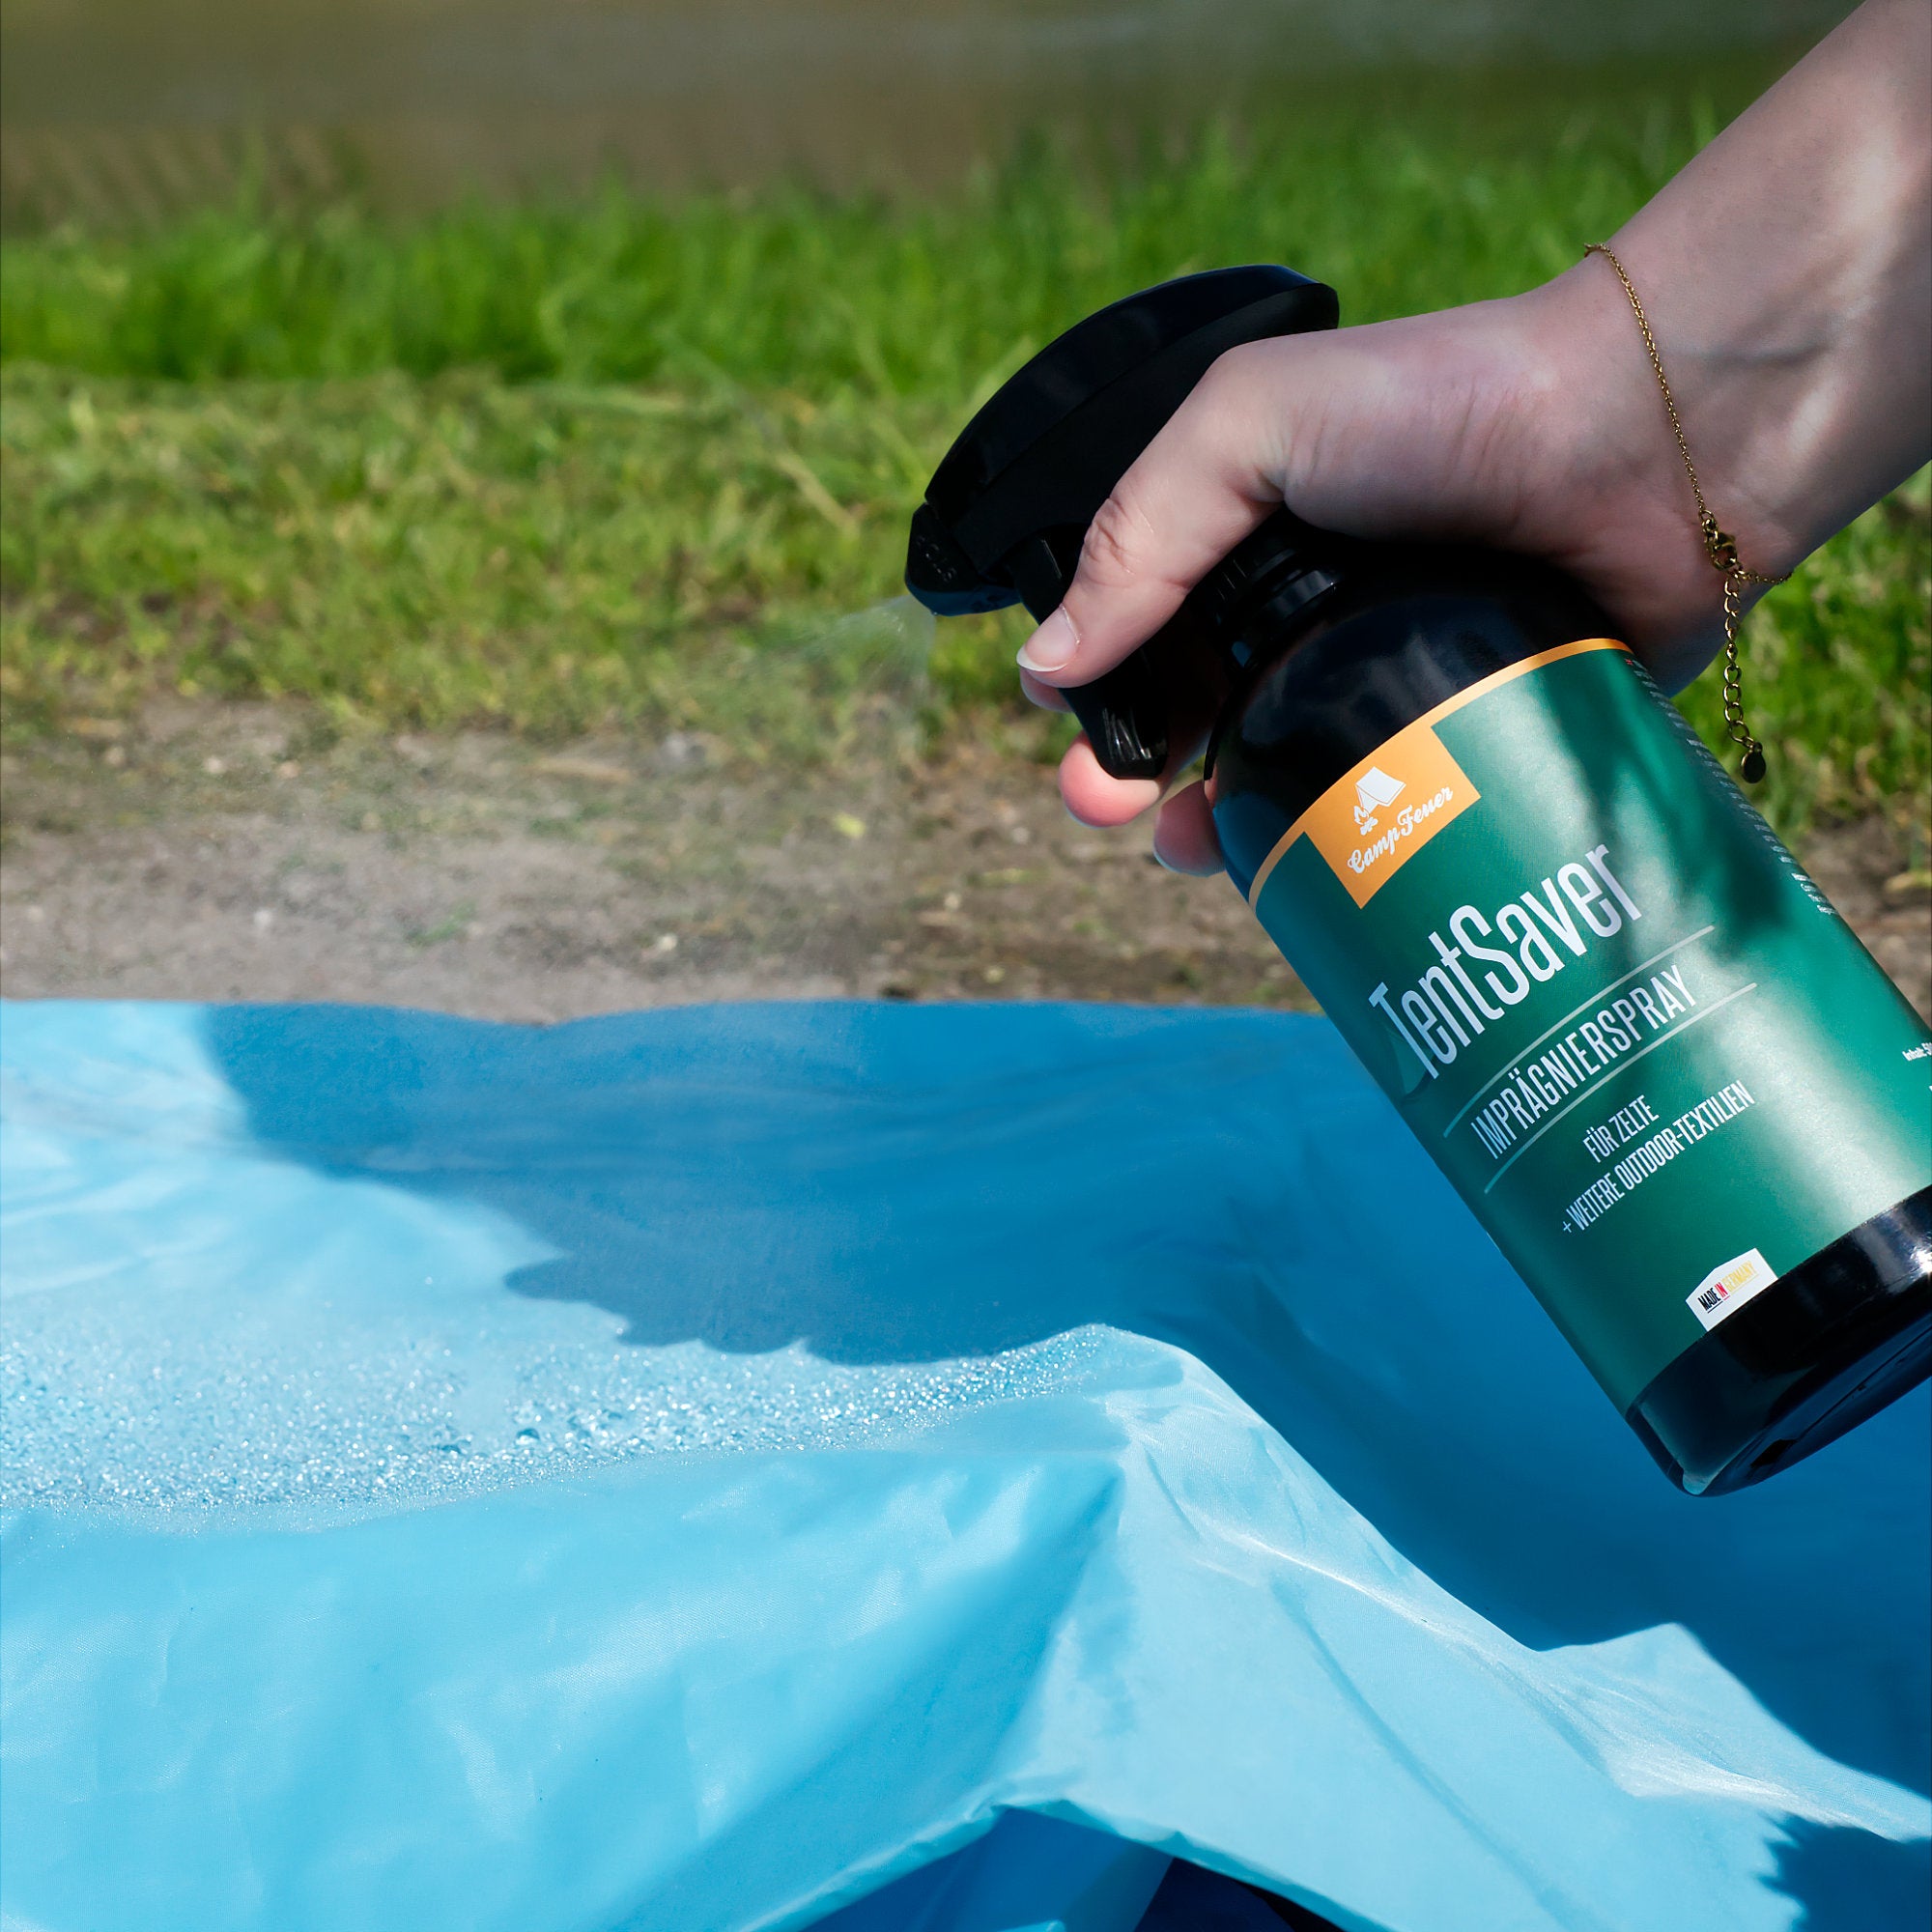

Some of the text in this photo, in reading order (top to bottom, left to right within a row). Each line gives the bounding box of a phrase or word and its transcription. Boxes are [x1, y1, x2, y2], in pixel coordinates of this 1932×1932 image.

[1368, 843, 1641, 1080] TentSaver
[1470, 964, 1696, 1160] IMPRÄGNIERSPRAY
[1582, 1094, 1660, 1163] FÜR ZELTE
[1563, 1079, 1756, 1234] + WEITERE OUTDOOR-TEXTILIEN
[1697, 1260, 1757, 1311] MADE IN GERMANY
